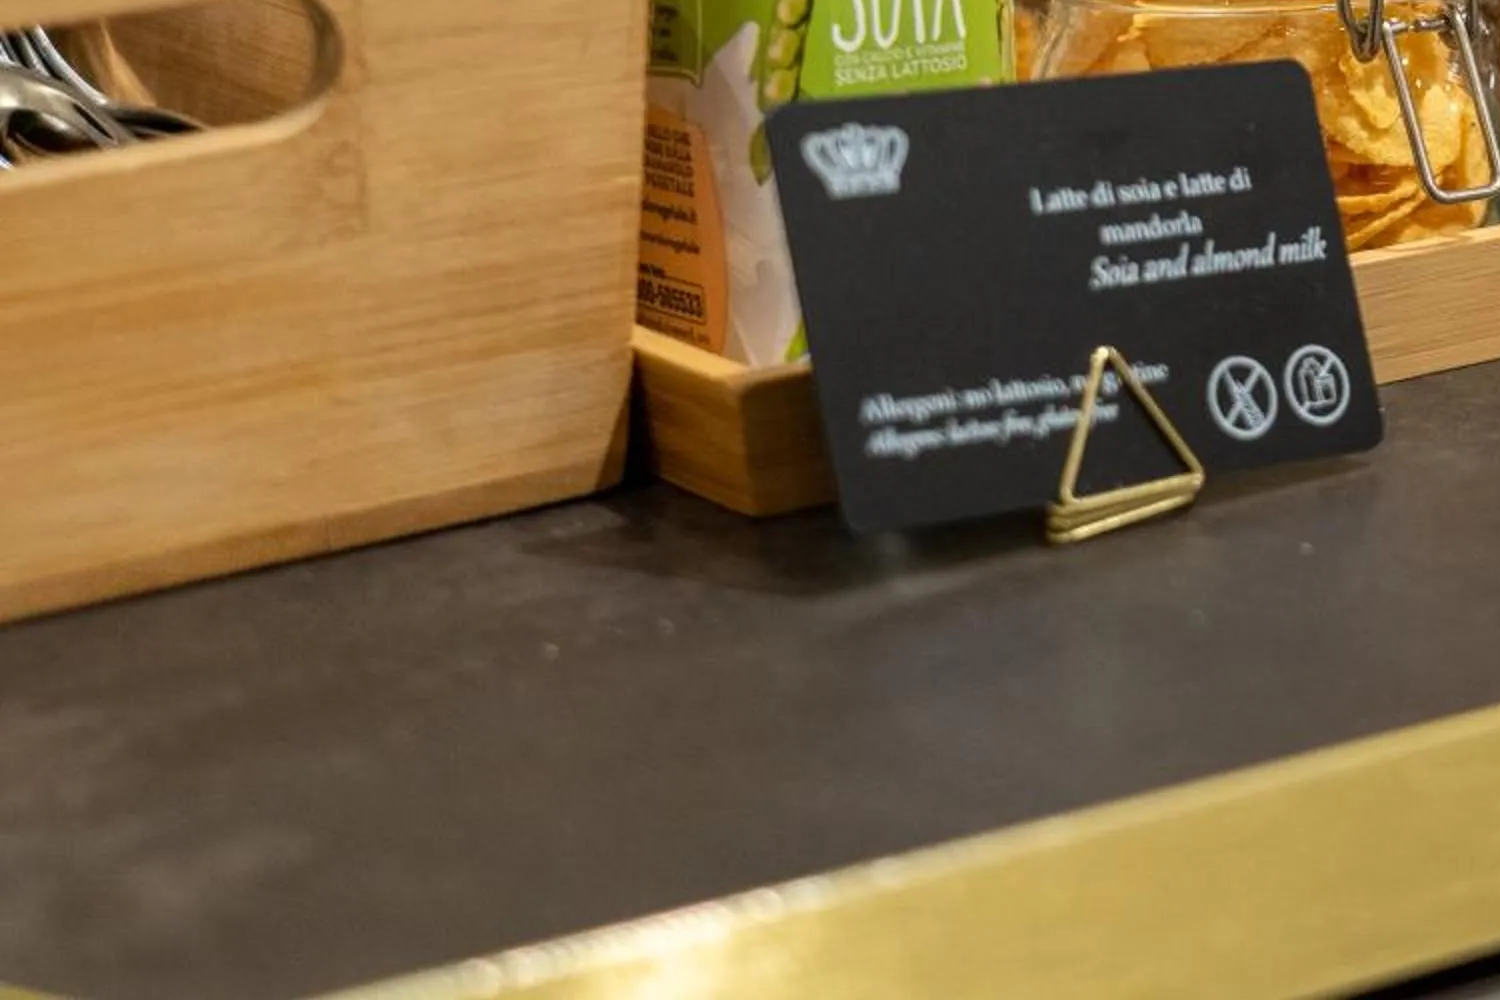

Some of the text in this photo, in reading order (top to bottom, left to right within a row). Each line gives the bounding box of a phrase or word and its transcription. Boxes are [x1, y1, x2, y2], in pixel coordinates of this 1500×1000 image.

[835, 54, 968, 87] SENZA LATTOSIO
[1029, 166, 1252, 215] Latte di soia e latte di
[1100, 210, 1203, 245] mandorla
[1089, 226, 1327, 291] Soia and almond milk
